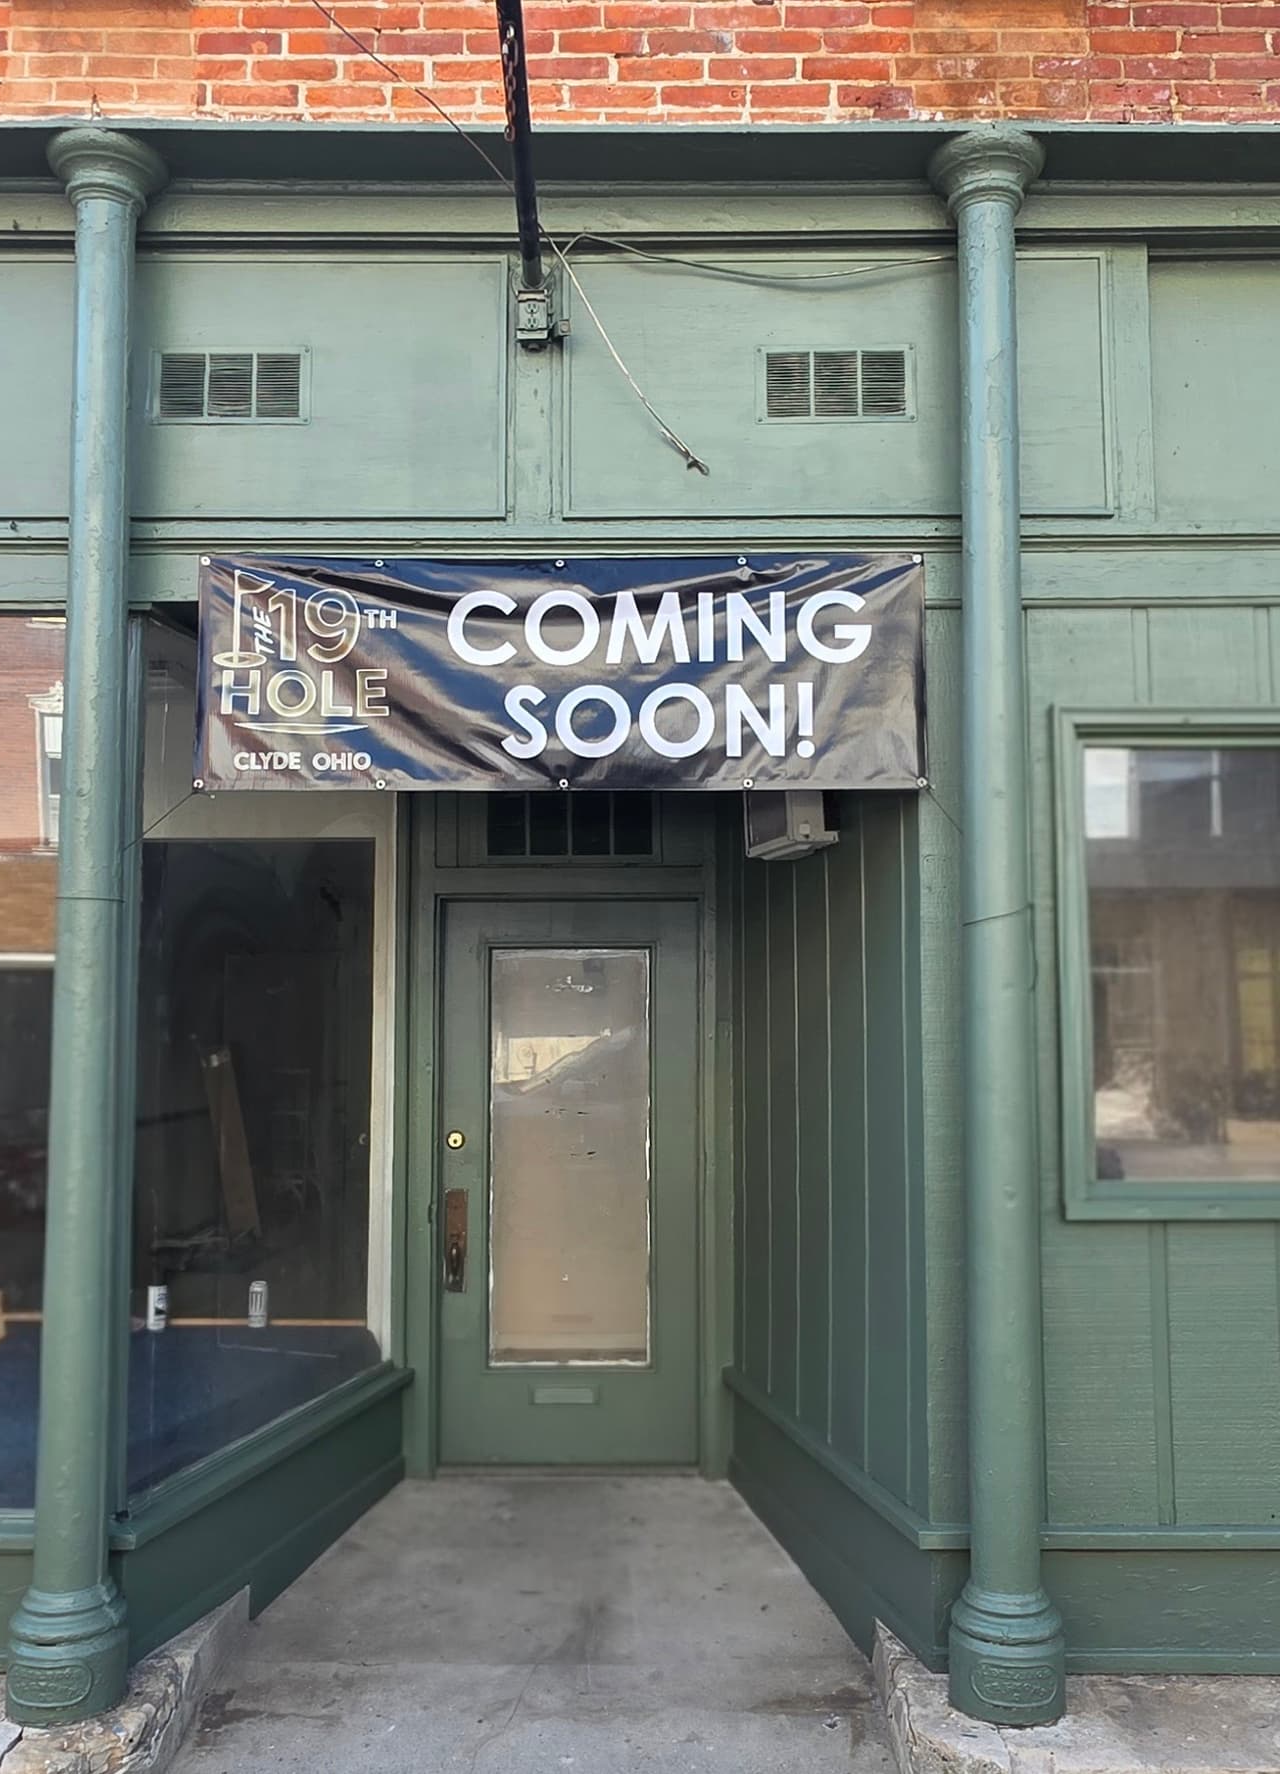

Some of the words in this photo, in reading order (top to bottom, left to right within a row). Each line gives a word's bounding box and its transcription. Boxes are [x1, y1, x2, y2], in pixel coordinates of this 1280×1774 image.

[252, 606, 276, 655] THE
[446, 590, 872, 665] COMING
[220, 668, 390, 718] HOLE
[501, 681, 816, 760] SOON!
[233, 751, 301, 771] CLYDE
[312, 752, 372, 771] OHIO
